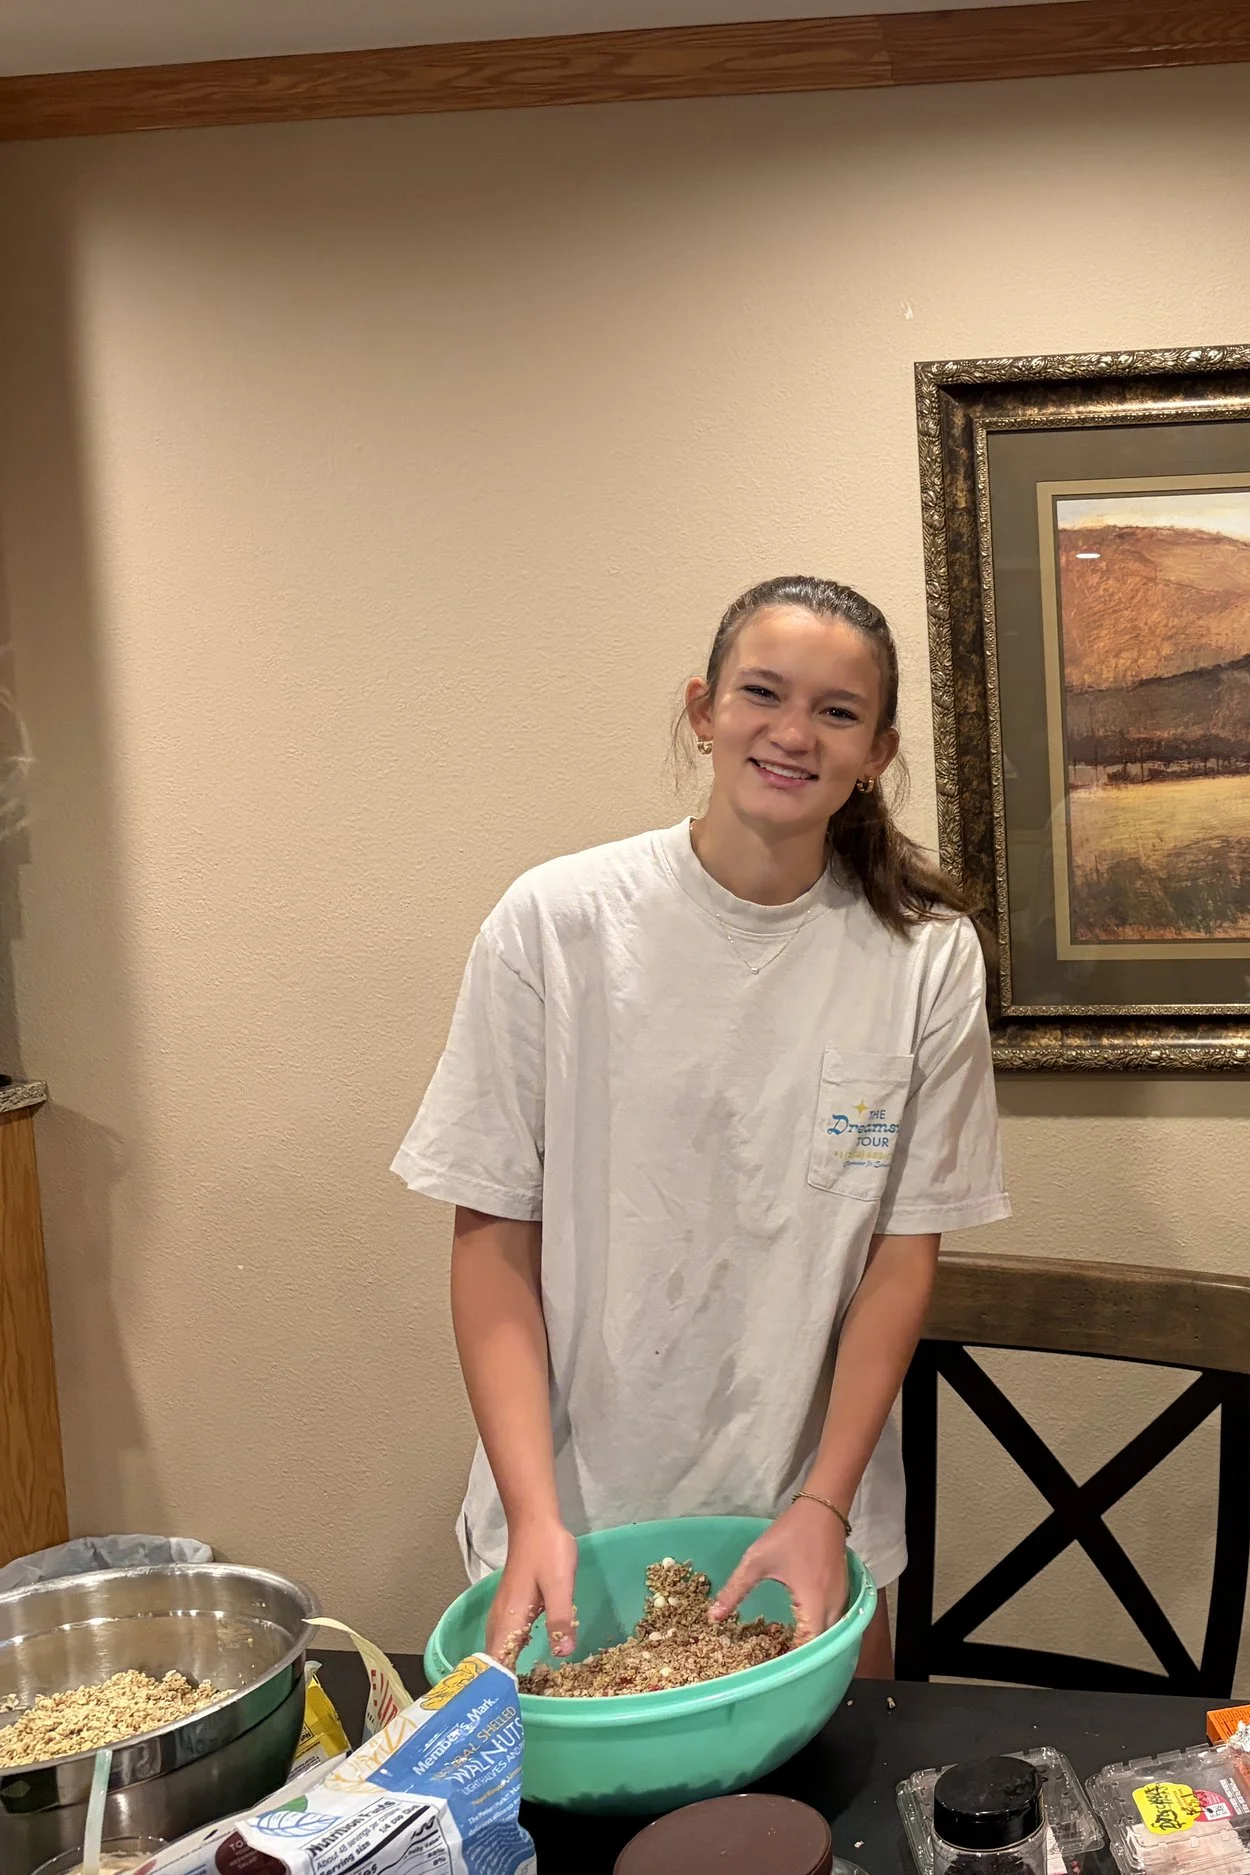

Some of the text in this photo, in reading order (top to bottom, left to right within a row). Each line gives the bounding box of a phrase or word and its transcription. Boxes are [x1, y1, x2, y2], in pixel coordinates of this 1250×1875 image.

[869, 1110, 886, 1120] THE
[857, 1137, 889, 1148] TOUR
[412, 1722, 468, 1776] Member's
[466, 1697, 496, 1723] Mark
[477, 1706, 517, 1742] SHELLED
[445, 1717, 525, 1784] WALNUTS
[305, 1814, 365, 1858] Nutrition
[355, 1841, 371, 1855] size
[316, 1850, 339, 1870] About
